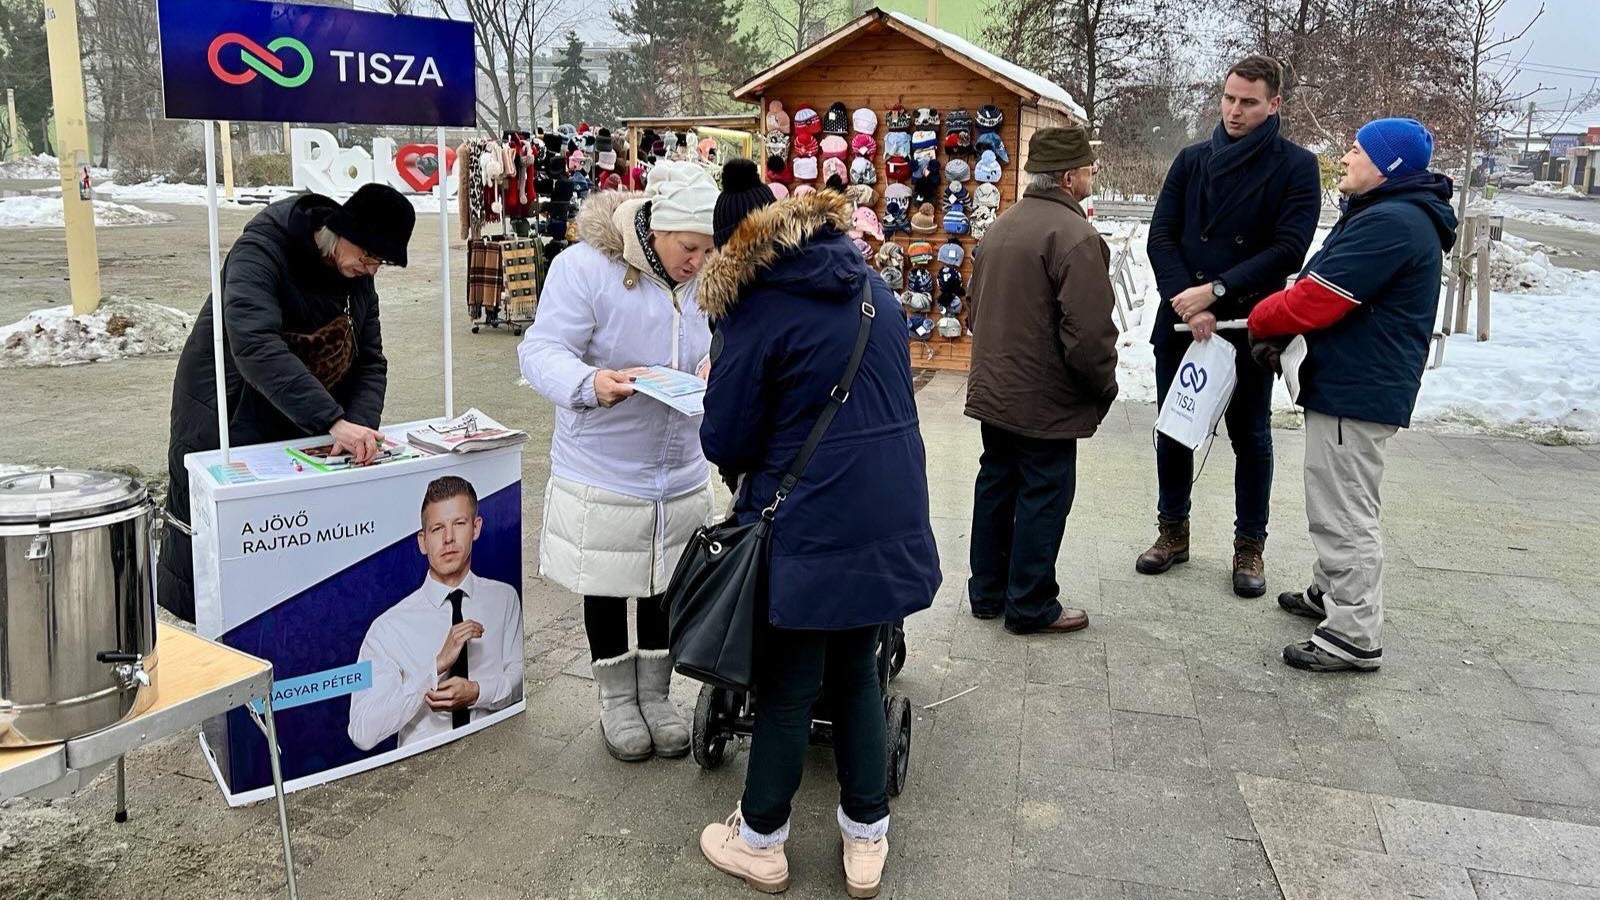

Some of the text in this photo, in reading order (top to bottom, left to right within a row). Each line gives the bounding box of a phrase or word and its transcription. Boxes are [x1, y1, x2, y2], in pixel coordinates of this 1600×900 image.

[330, 50, 444, 87] TISZA
[1175, 391, 1196, 414] TISZA
[241, 510, 309, 535] A JÖVŐ
[243, 520, 375, 554] RAJTAD MÚLIK!
[322, 672, 362, 690] PÉTER
